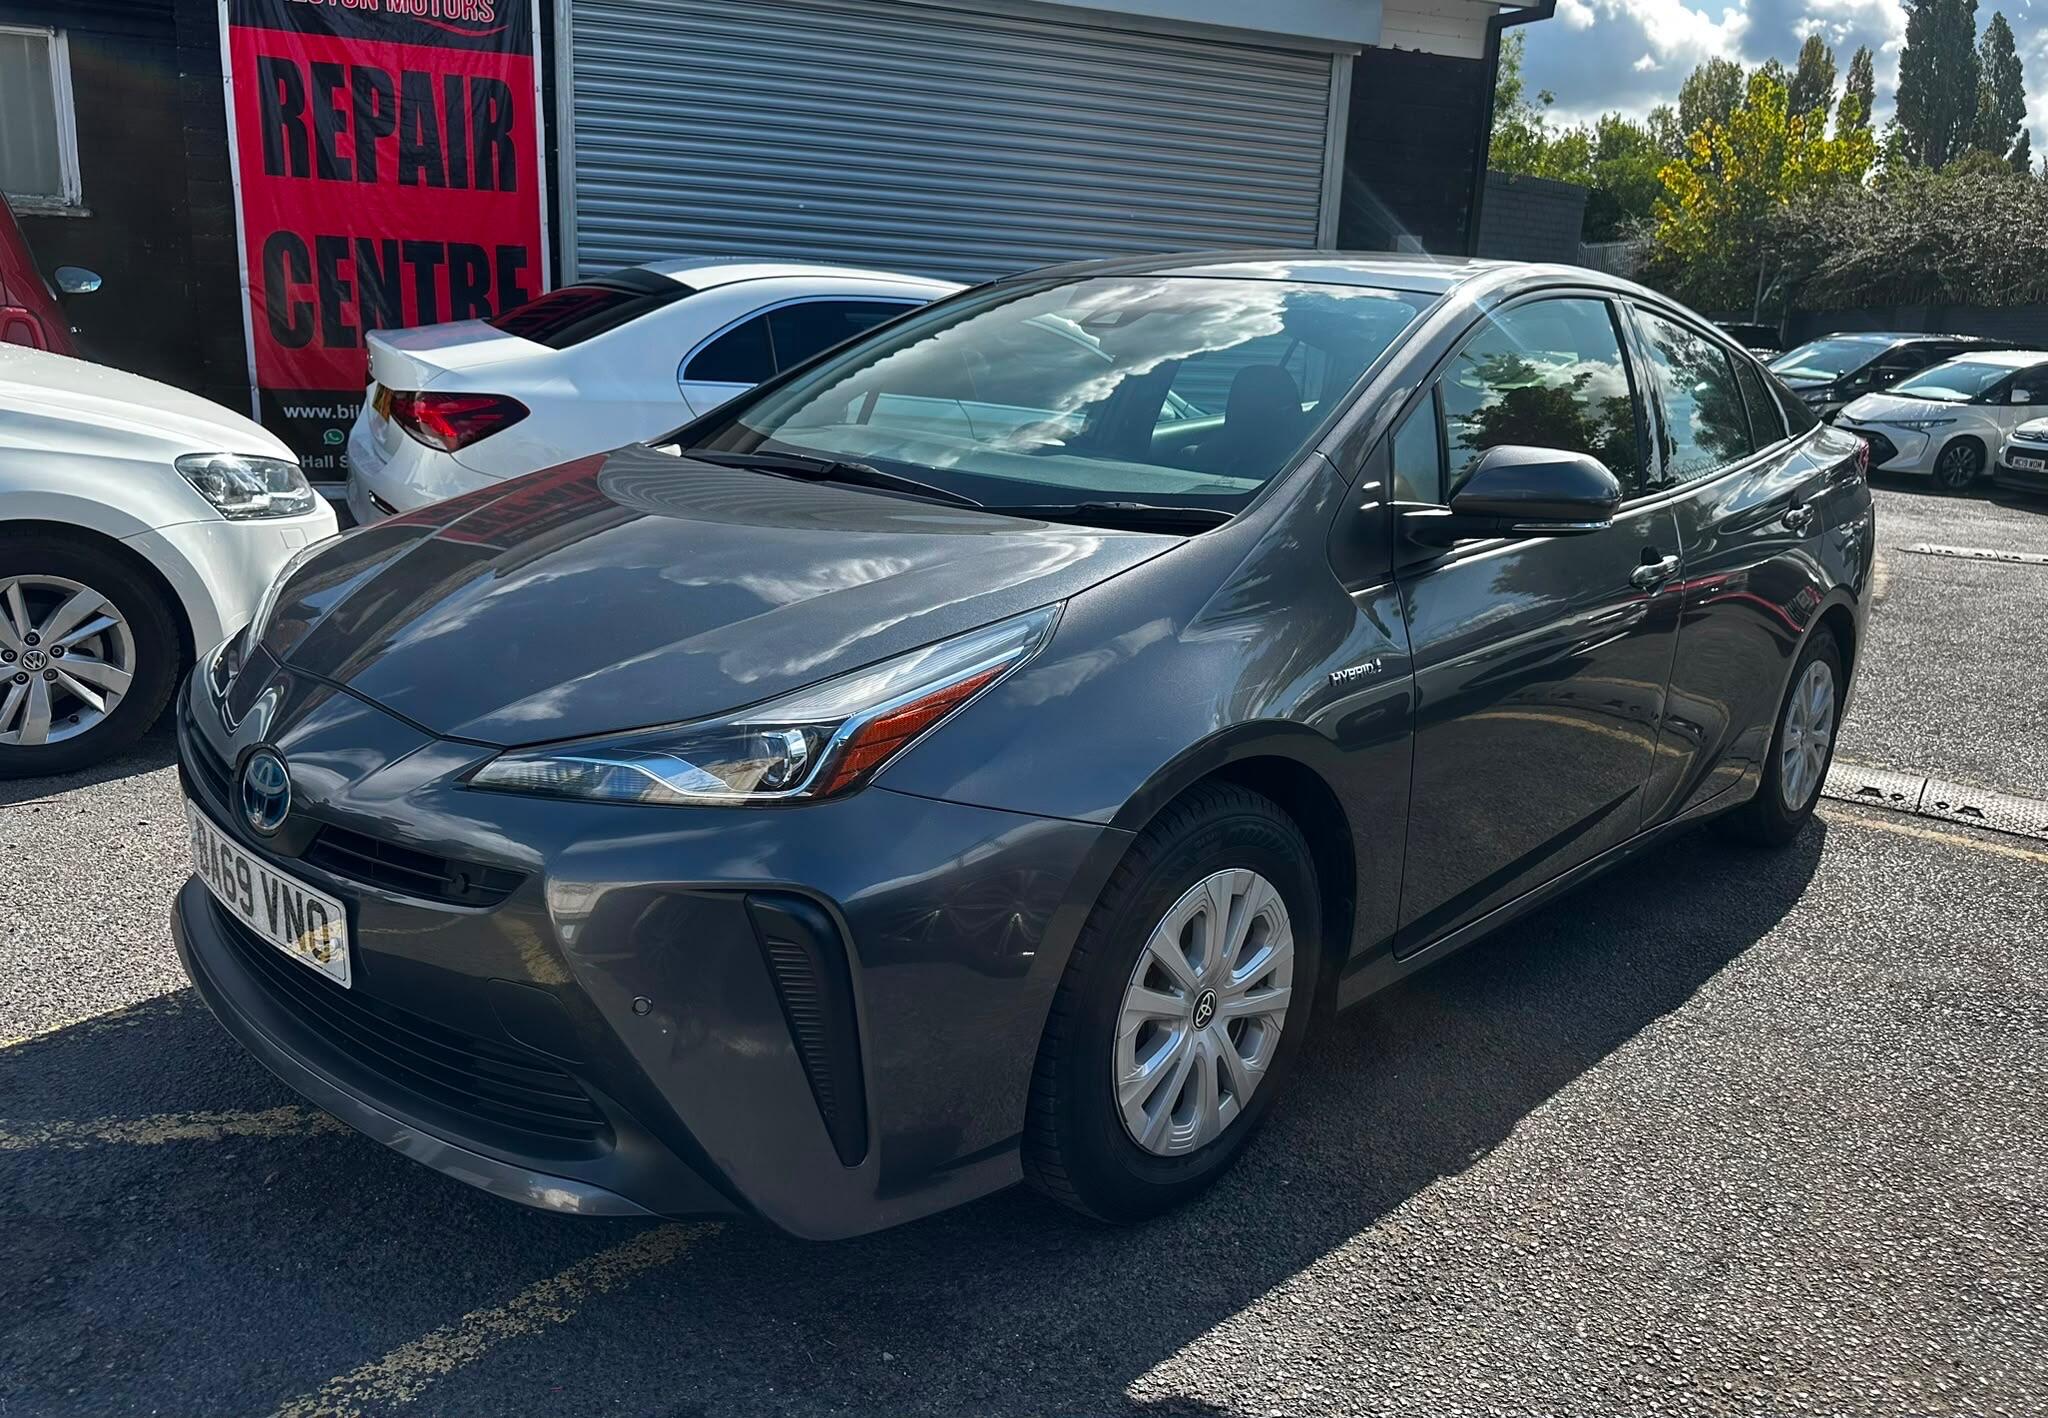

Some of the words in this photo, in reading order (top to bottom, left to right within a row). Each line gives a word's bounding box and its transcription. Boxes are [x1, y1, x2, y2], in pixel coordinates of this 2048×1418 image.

[257, 55, 517, 192] REPAIR
[263, 230, 527, 350] CENTRE
[301, 455, 333, 469] Hall
[339, 455, 349, 469] S
[1328, 661, 1376, 686] HYBRID
[260, 870, 331, 964] VNO
